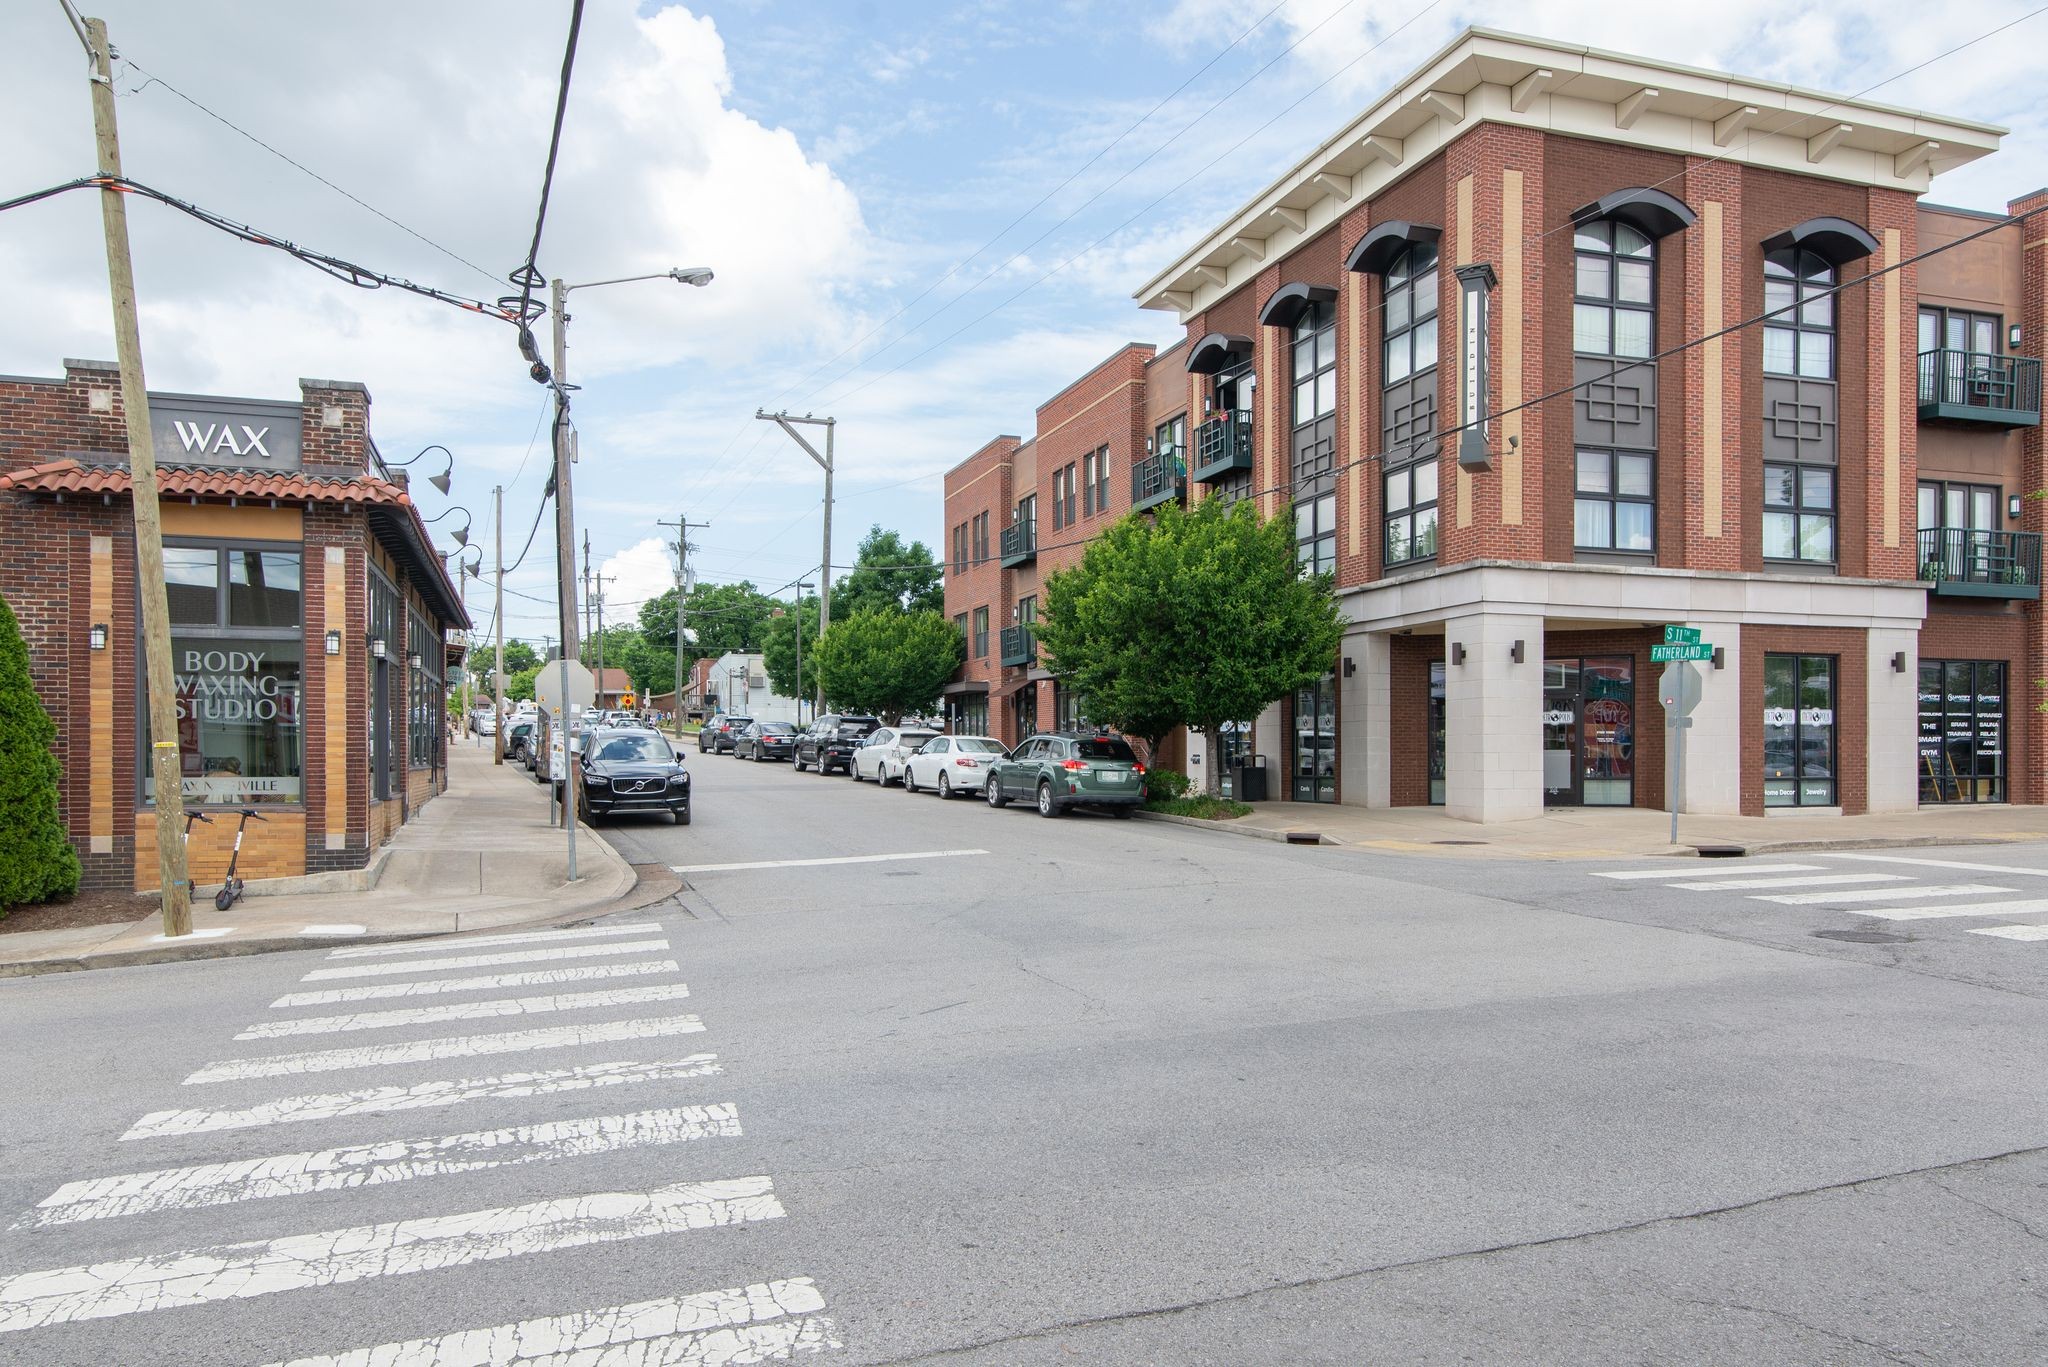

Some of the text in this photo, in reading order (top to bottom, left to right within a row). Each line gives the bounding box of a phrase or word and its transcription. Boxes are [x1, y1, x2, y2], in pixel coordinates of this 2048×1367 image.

[173, 420, 271, 457] WAX
[1666, 627, 1673, 640] S
[185, 650, 266, 672] BODY
[1652, 646, 1701, 660] FATHERLAND
[174, 674, 279, 696] WAXING
[175, 698, 278, 720] STUDIO
[182, 781, 198, 792] AX
